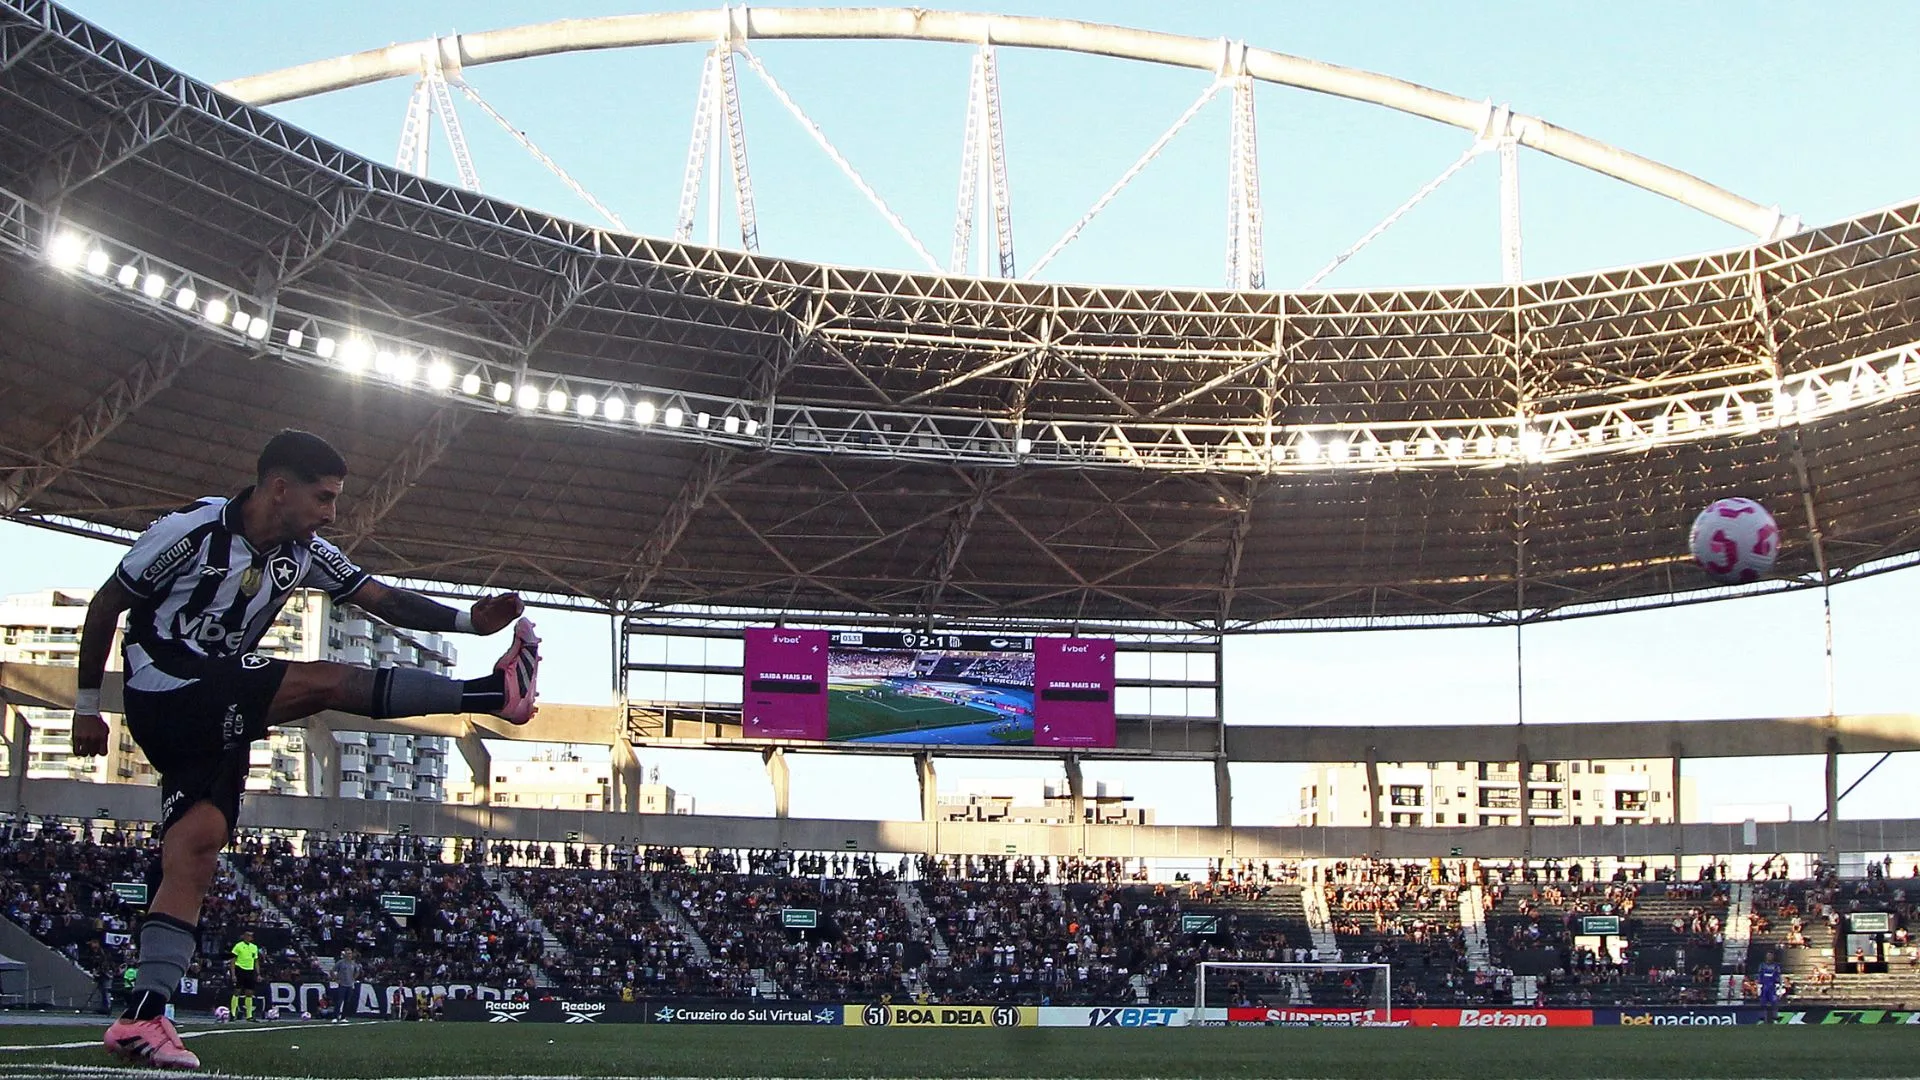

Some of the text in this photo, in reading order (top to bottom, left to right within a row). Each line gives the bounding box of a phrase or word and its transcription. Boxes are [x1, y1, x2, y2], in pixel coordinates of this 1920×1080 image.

[143, 537, 192, 581] Centrum
[778, 635, 801, 645] vbet
[1067, 644, 1090, 653] vbet
[782, 673, 800, 681] MAIS
[1071, 681, 1089, 689] MAIS
[485, 1001, 529, 1011] Reebok
[562, 1001, 606, 1012] Reebok
[676, 1008, 812, 1022] Cruzeiro do Sul Virtual
[867, 1007, 1014, 1025] 51 BOA IDEIA 51
[1088, 1008, 1178, 1026] 1XBET
[1458, 1010, 1547, 1027] Betano
[1620, 1011, 1737, 1025] betnacional
